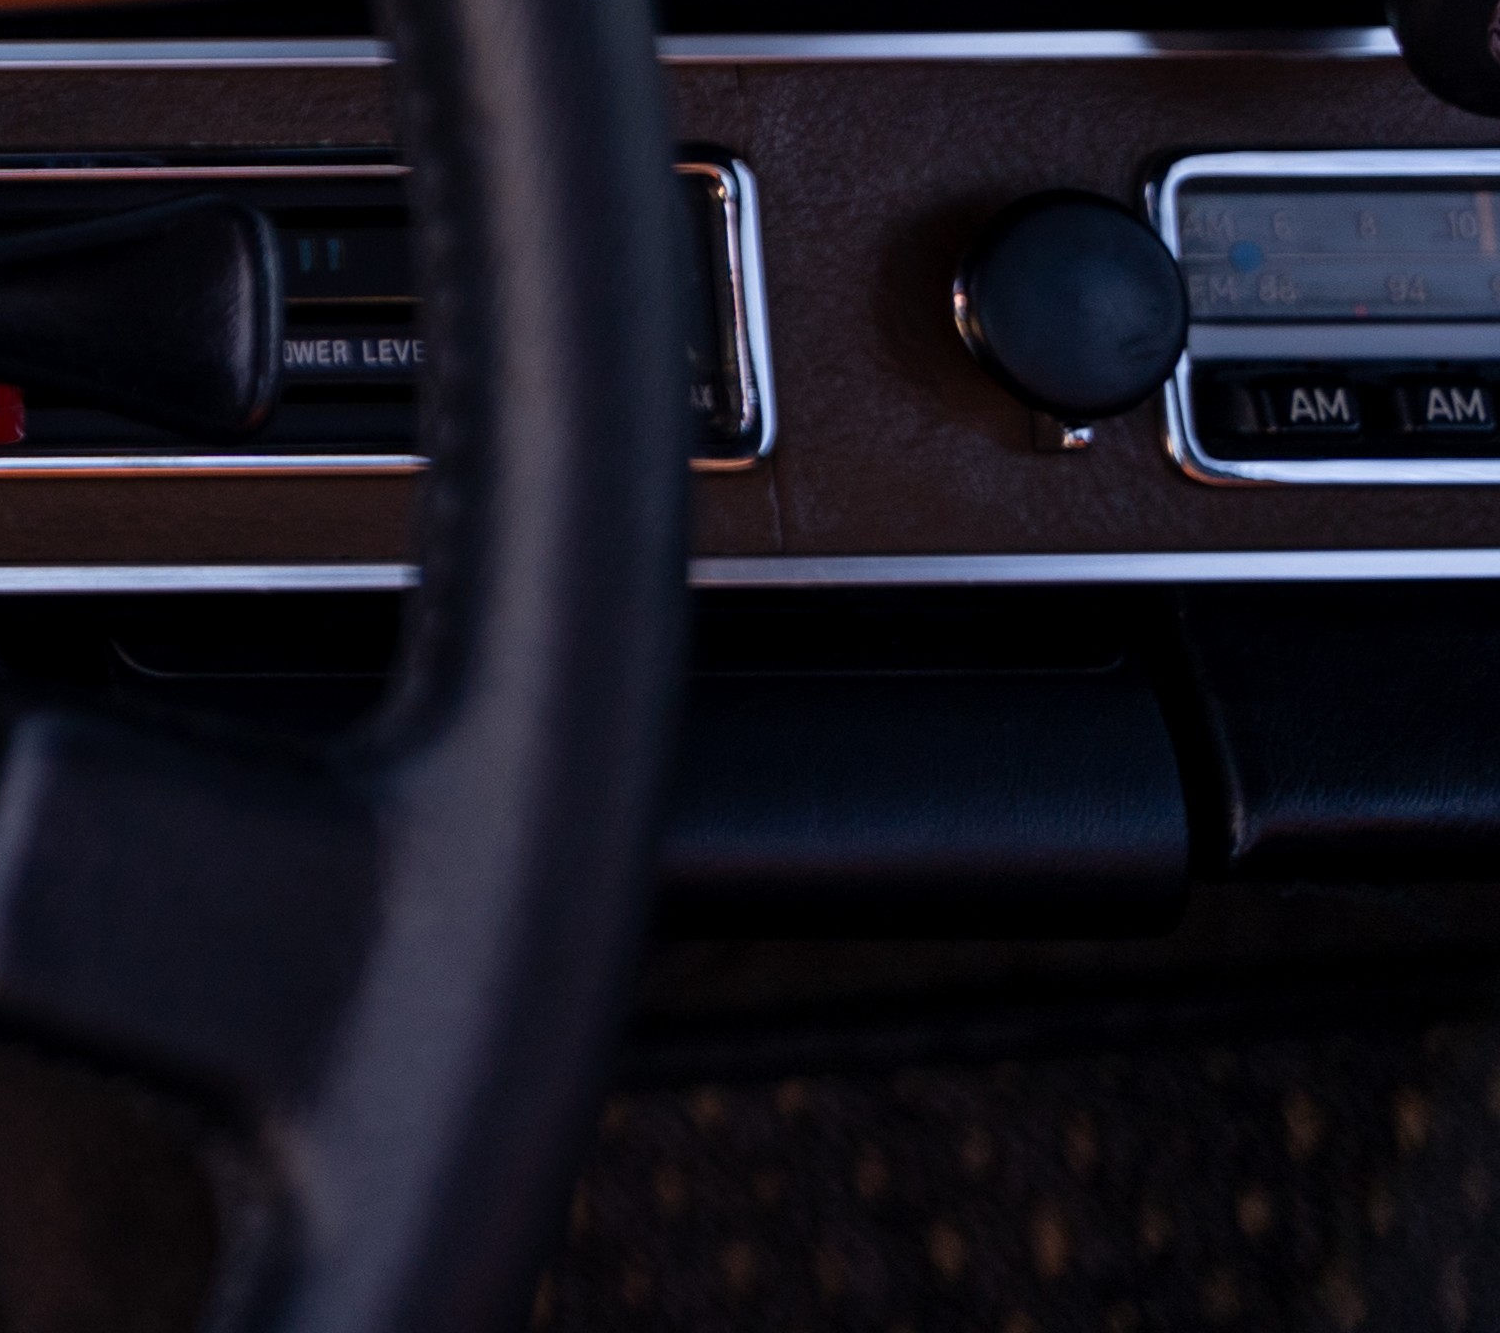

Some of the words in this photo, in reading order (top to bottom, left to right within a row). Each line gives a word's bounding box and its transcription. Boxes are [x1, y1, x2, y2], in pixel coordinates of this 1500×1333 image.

[361, 338, 428, 364] LEVE
[1289, 386, 1351, 422] AM
[1426, 386, 1487, 422] AM
